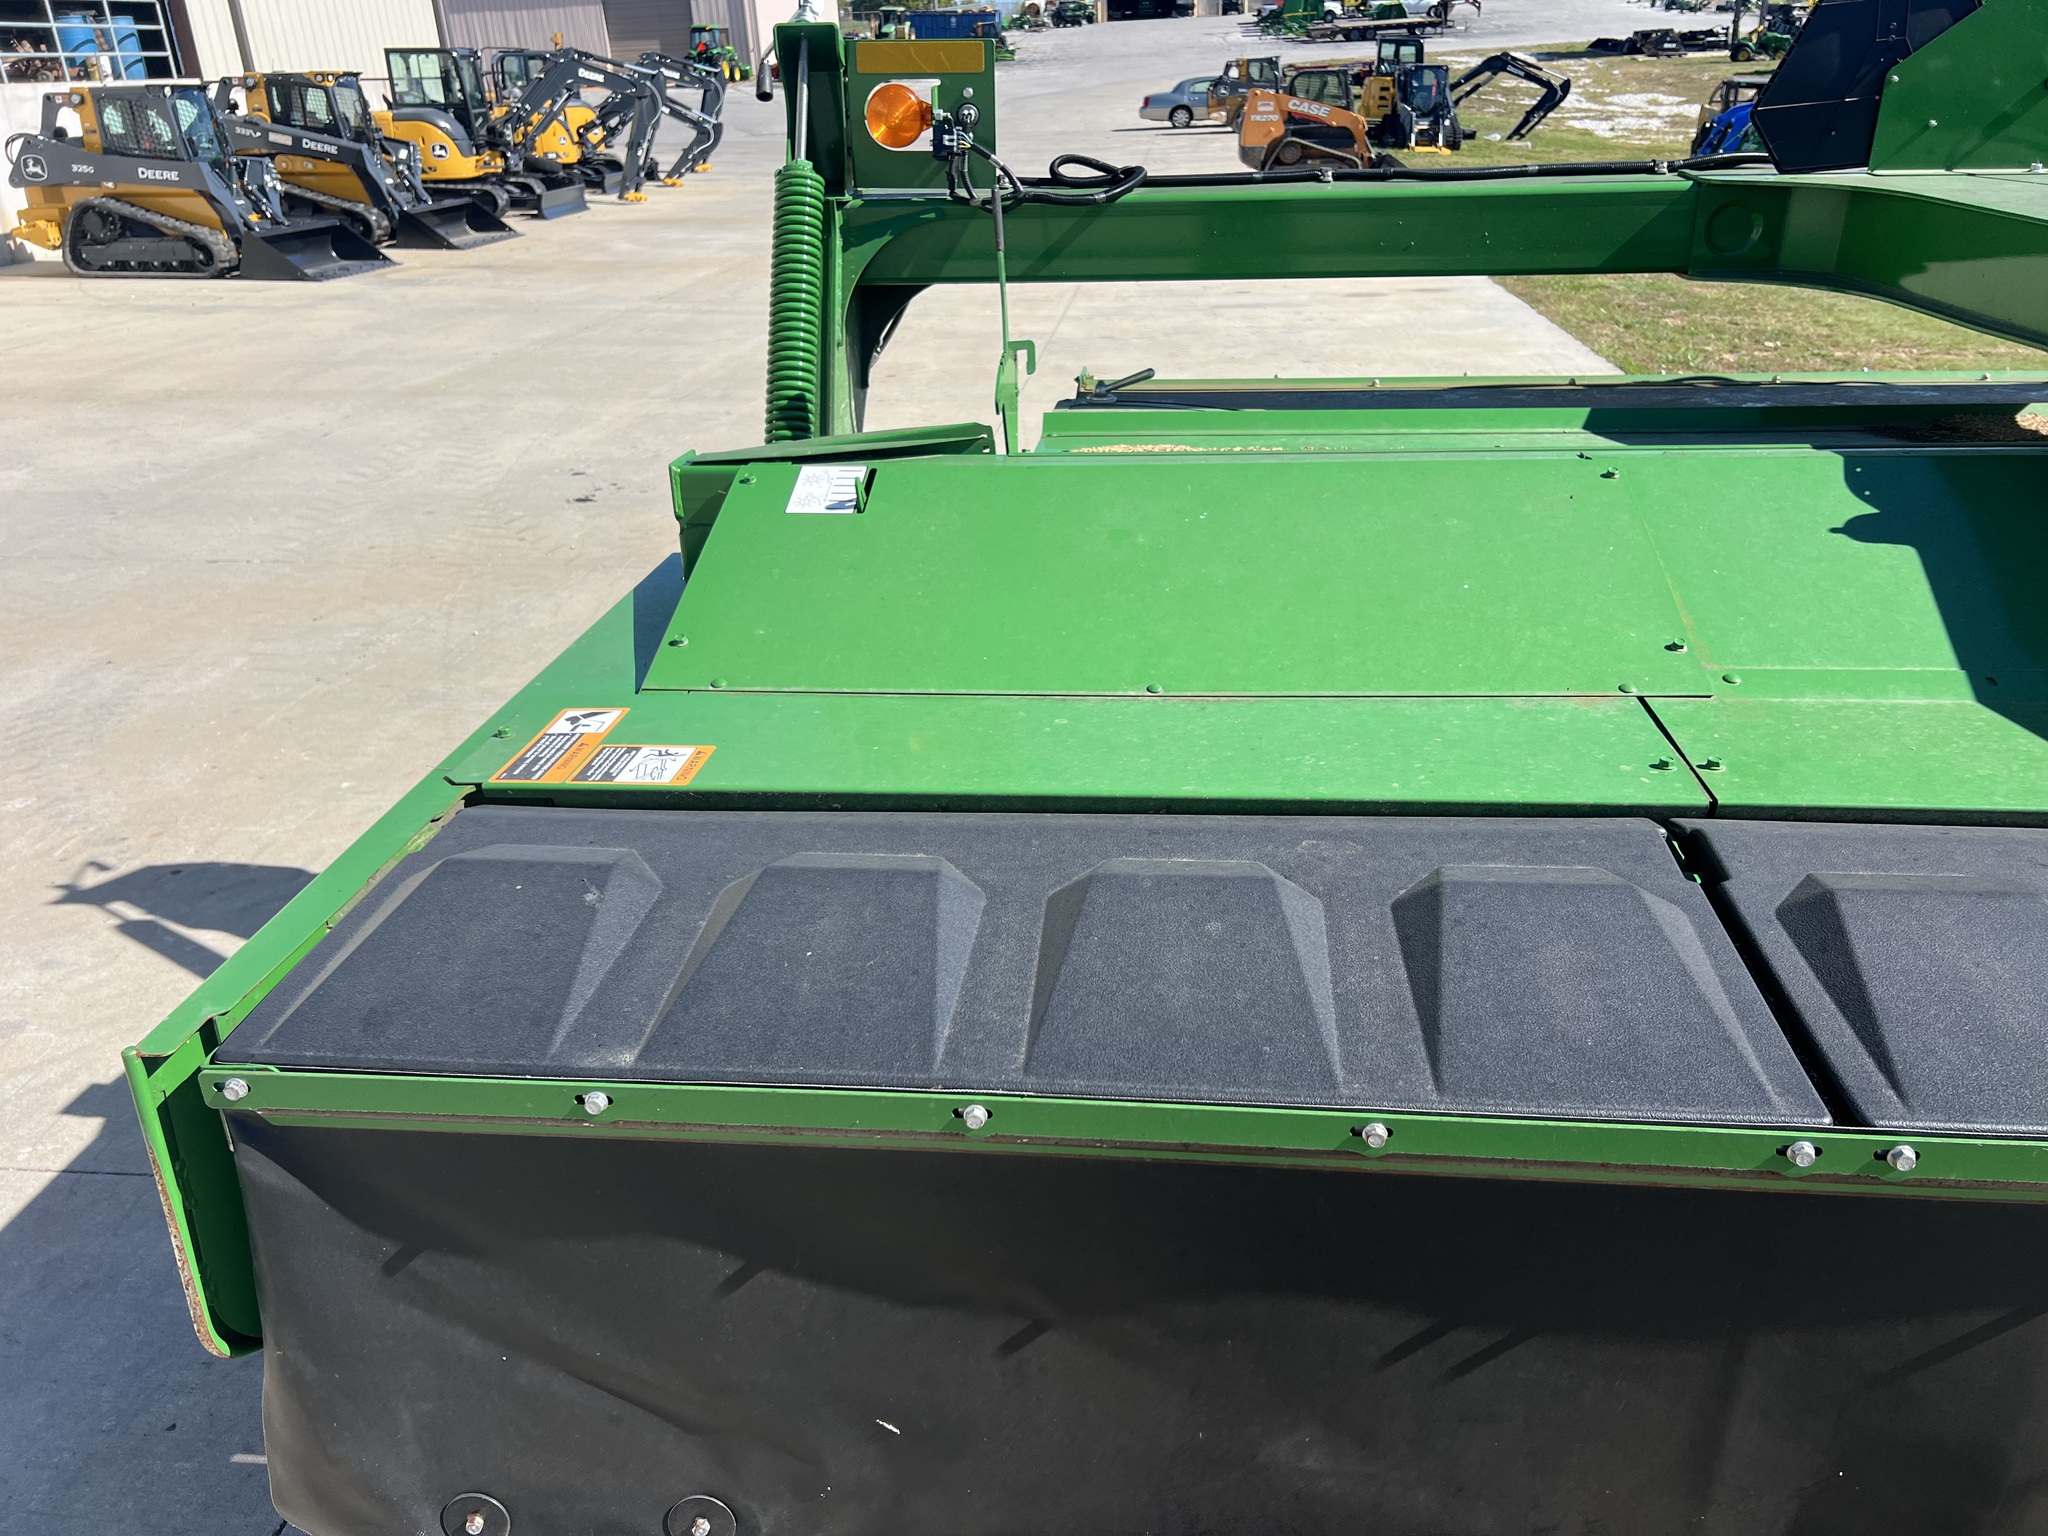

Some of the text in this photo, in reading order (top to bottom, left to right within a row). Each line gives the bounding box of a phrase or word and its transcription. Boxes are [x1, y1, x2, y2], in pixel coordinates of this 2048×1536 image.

[578, 68, 605, 83] DEERE
[1288, 100, 1331, 117] CASE
[301, 138, 338, 155] DEERE
[71, 163, 95, 174] 325G
[137, 166, 180, 182] DEERE
[676, 755, 703, 781] WARNING
